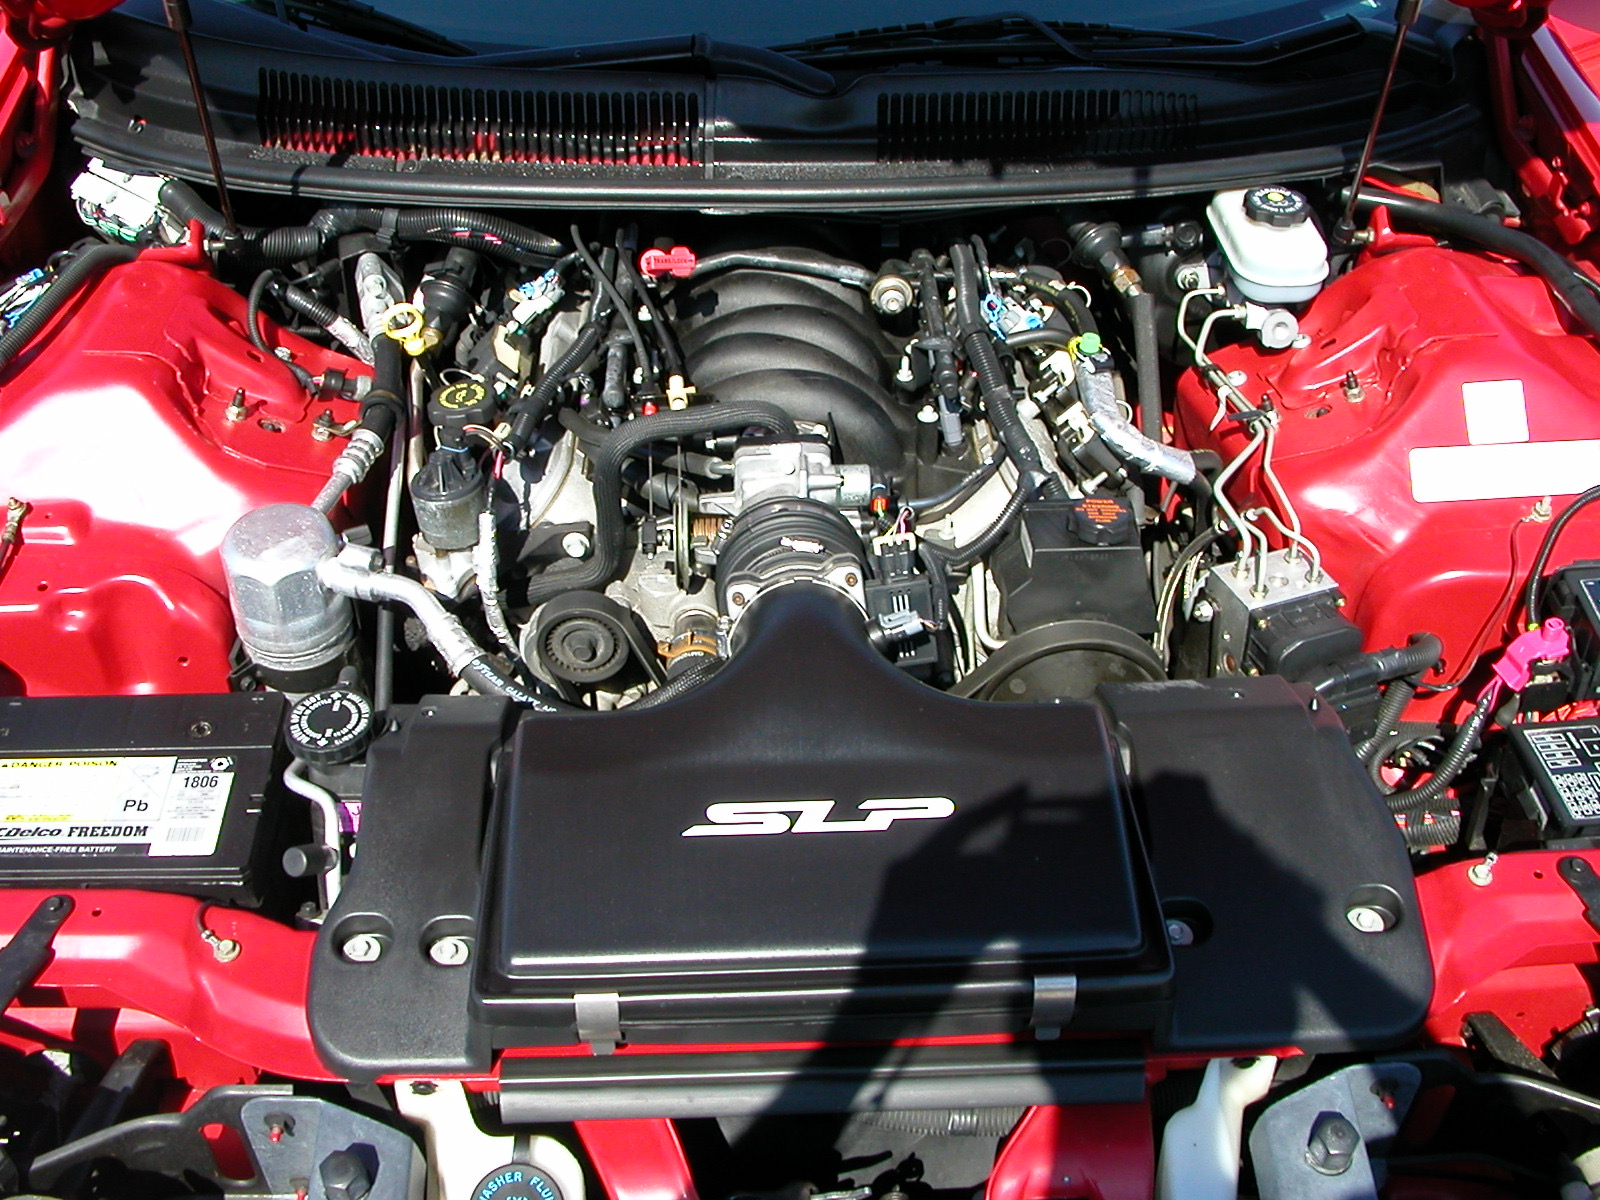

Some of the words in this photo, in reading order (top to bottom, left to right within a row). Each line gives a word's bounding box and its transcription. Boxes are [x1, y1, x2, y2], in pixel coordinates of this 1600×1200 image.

[303, 693, 321, 707] HOT
[184, 775, 219, 788] 1806
[123, 799, 149, 812] Pb
[680, 796, 955, 837] SLP
[67, 825, 149, 837] FREEDOM
[0, 845, 77, 853] AINTENANCE-FREE
[78, 845, 117, 853] BATTERY
[478, 1170, 523, 1200] ASHER
